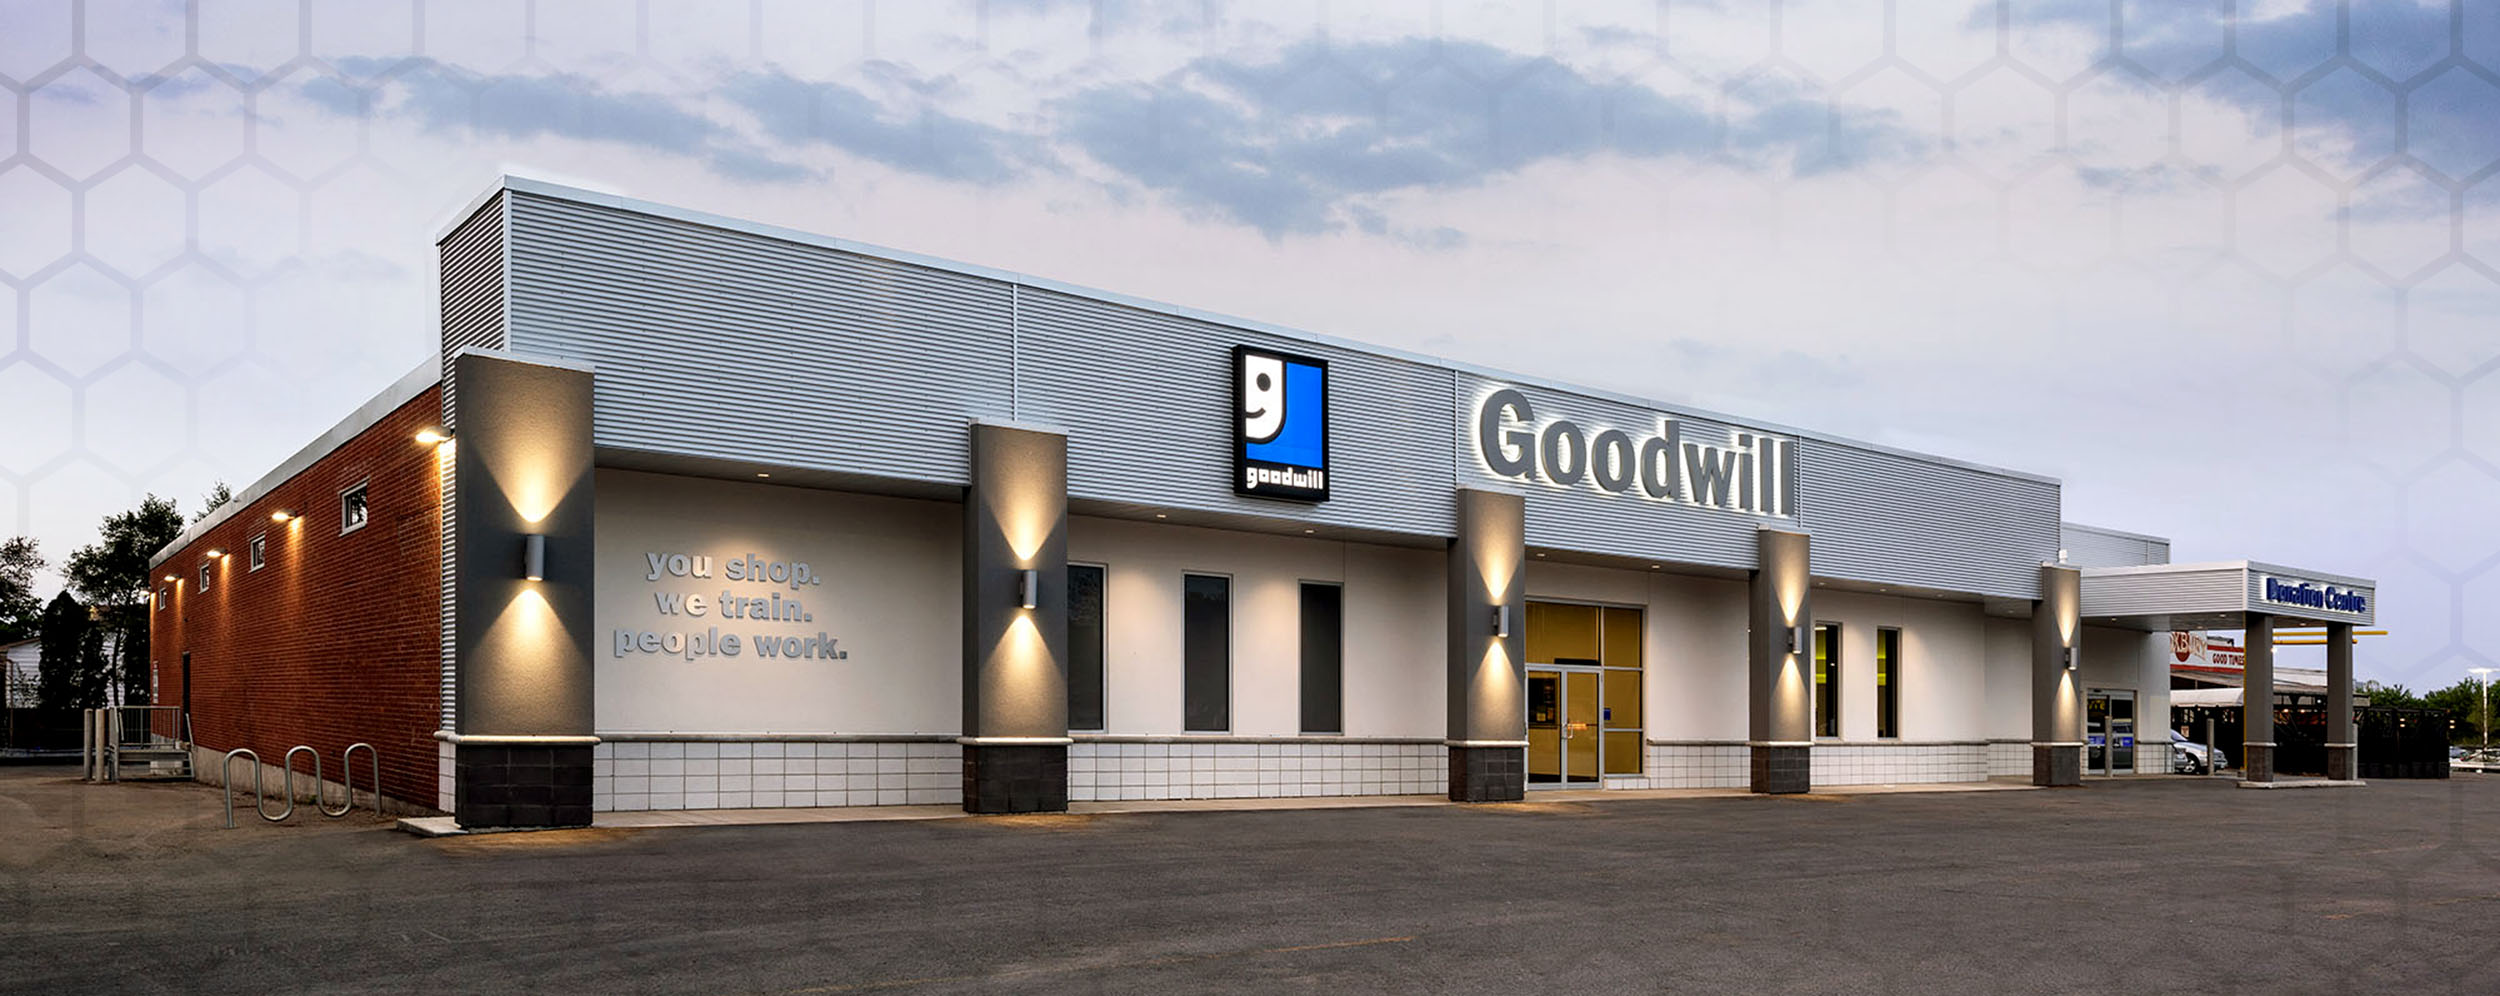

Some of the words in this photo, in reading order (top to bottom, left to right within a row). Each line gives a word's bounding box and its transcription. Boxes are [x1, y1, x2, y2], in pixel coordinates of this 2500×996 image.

[1480, 389, 1796, 516] Goodwill
[1246, 466, 1324, 490] goodwill
[646, 552, 713, 581] you
[725, 553, 820, 589] shop.
[654, 591, 708, 615] we
[719, 590, 813, 622] train.
[2266, 577, 2323, 608] Donation
[2325, 586, 2366, 613] Centre
[614, 627, 741, 661] people
[754, 632, 848, 660] work.
[2212, 652, 2228, 665] GOOD
